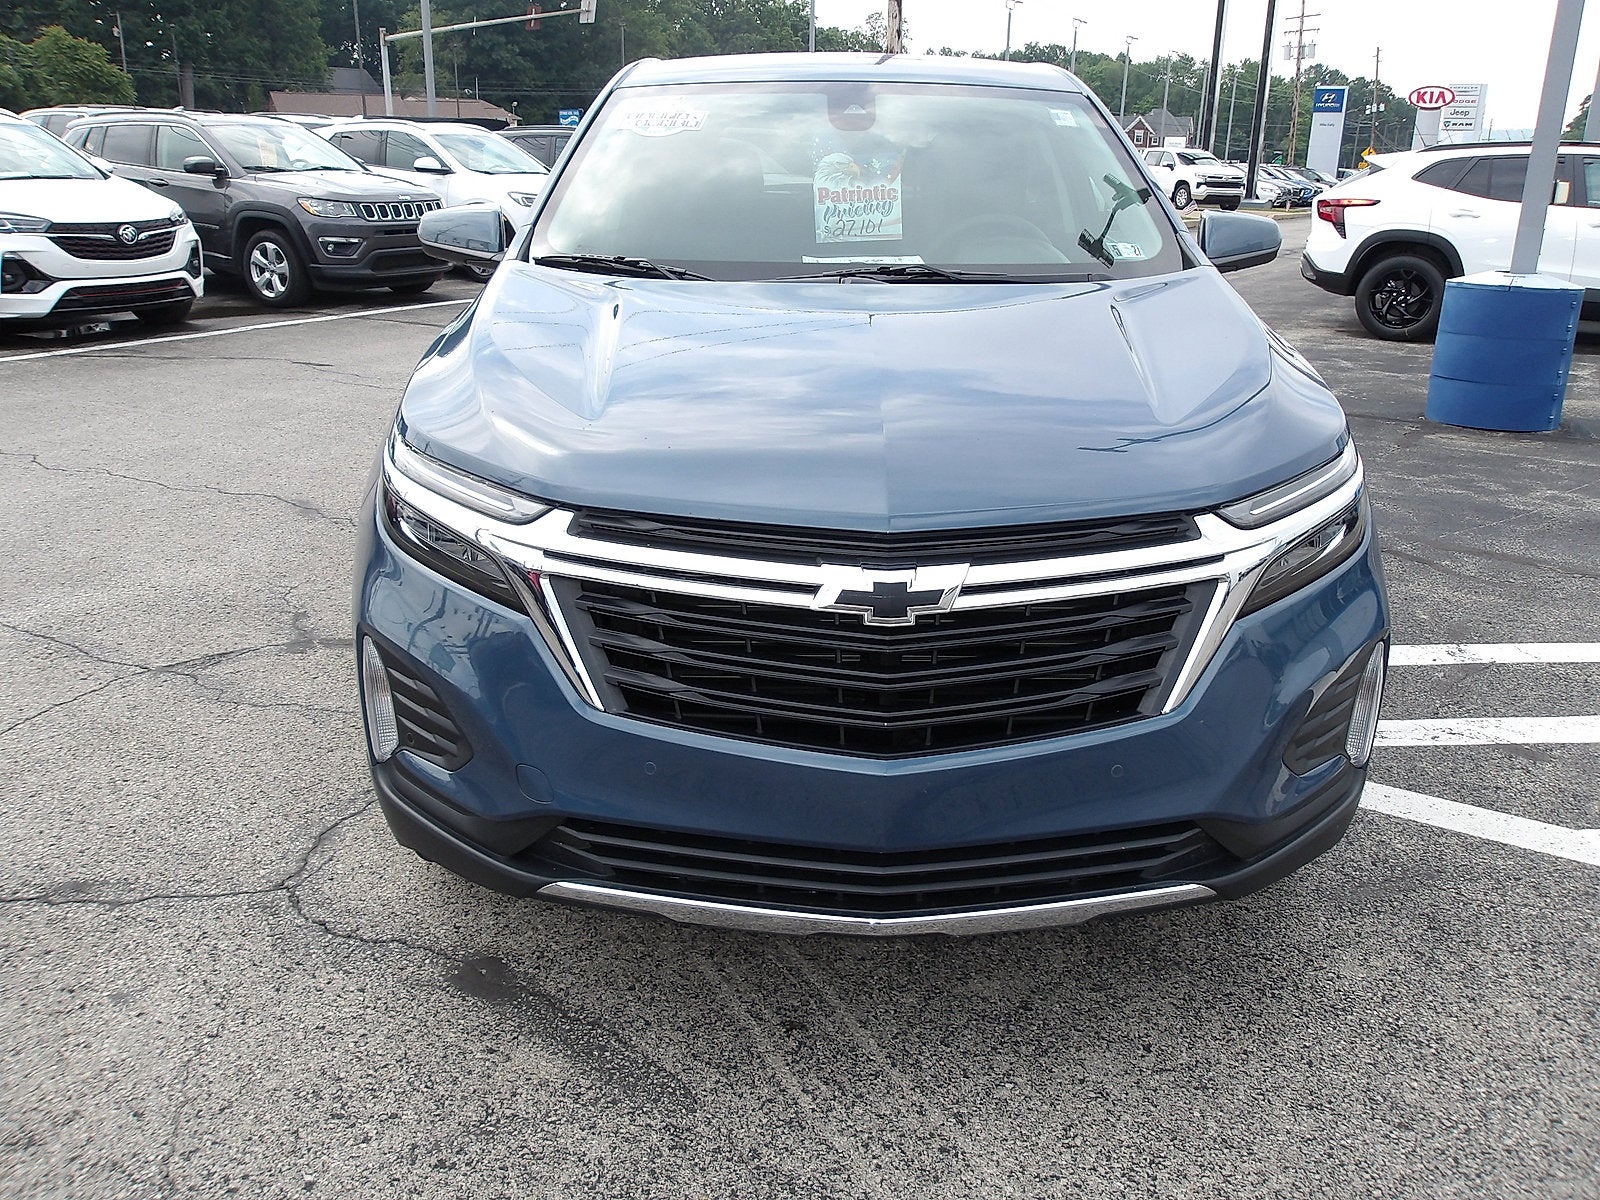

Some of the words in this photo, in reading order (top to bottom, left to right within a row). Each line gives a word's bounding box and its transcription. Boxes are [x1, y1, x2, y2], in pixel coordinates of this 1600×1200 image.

[1416, 91, 1447, 104] KIA
[1449, 109, 1470, 117] Jeep
[817, 184, 898, 205] Patriotic
[823, 199, 894, 225] Pricing
